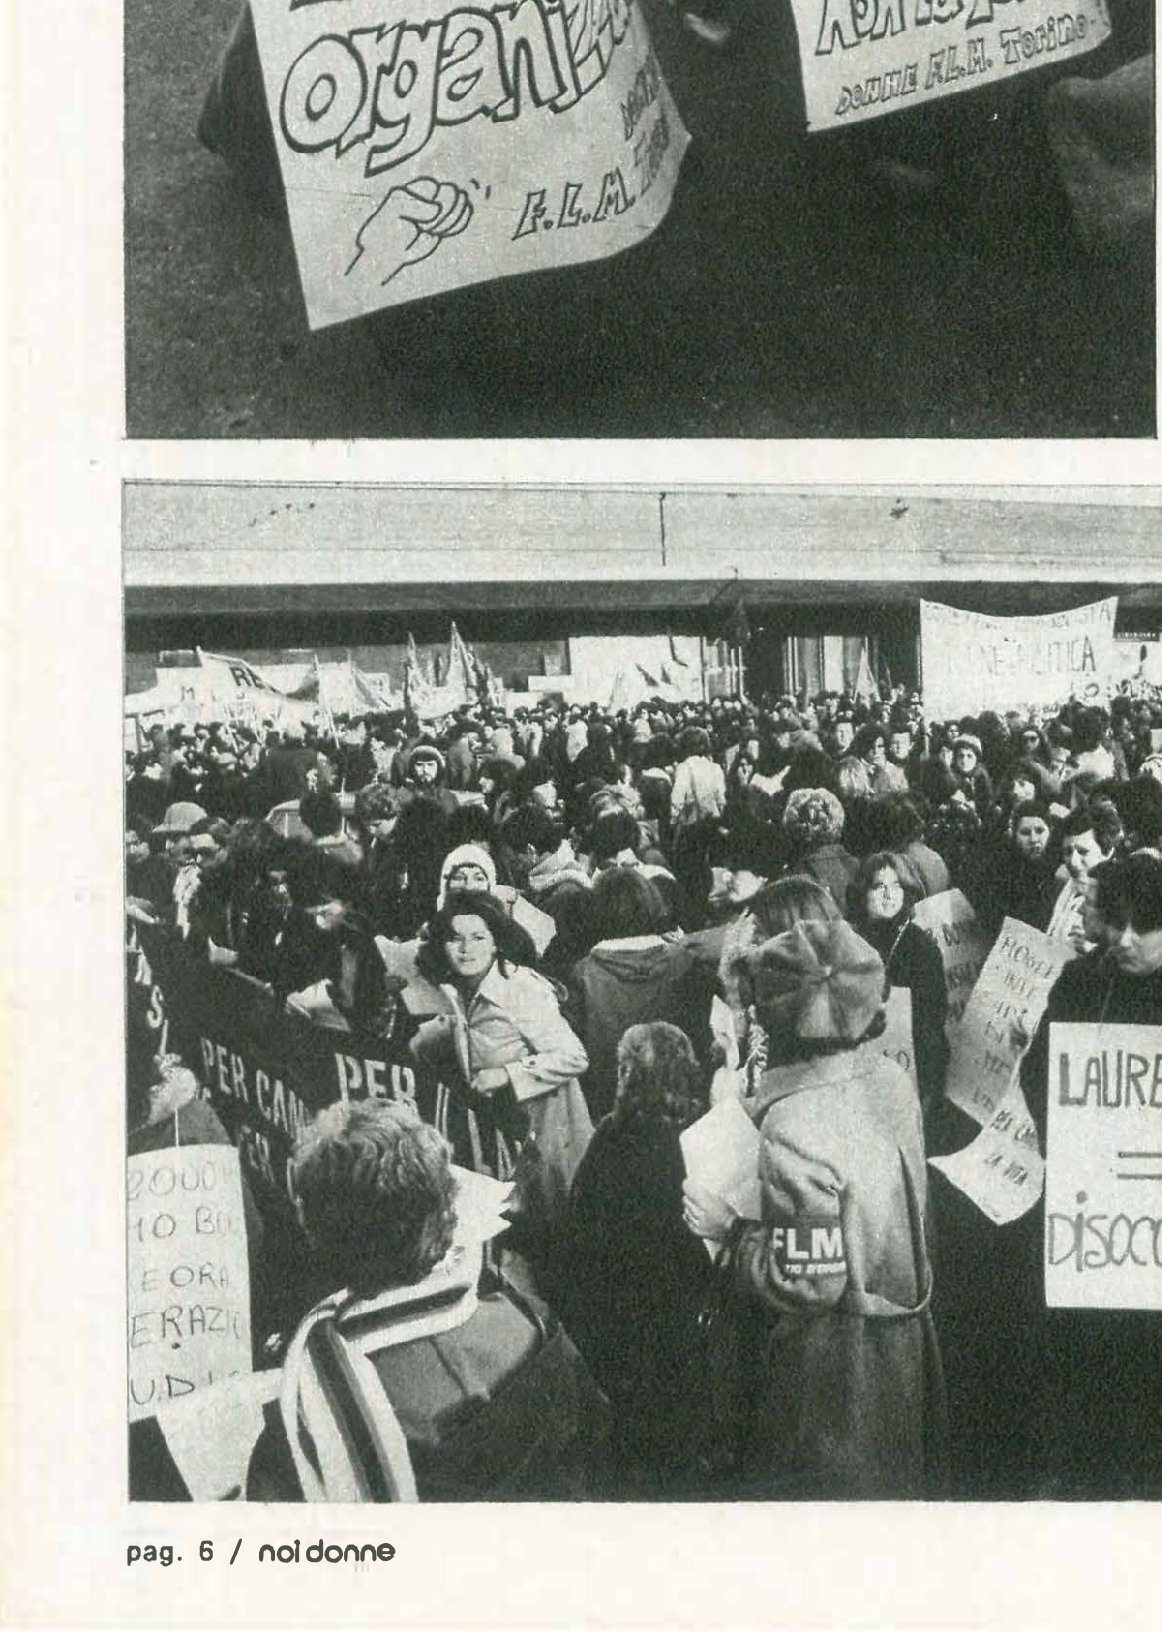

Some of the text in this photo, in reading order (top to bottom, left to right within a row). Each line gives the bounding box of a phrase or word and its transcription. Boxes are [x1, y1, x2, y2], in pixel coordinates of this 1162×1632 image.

[773, 1227, 843, 1259] FLM
[127, 1545, 182, 1567] pag.
[199, 1540, 214, 1562] 6
